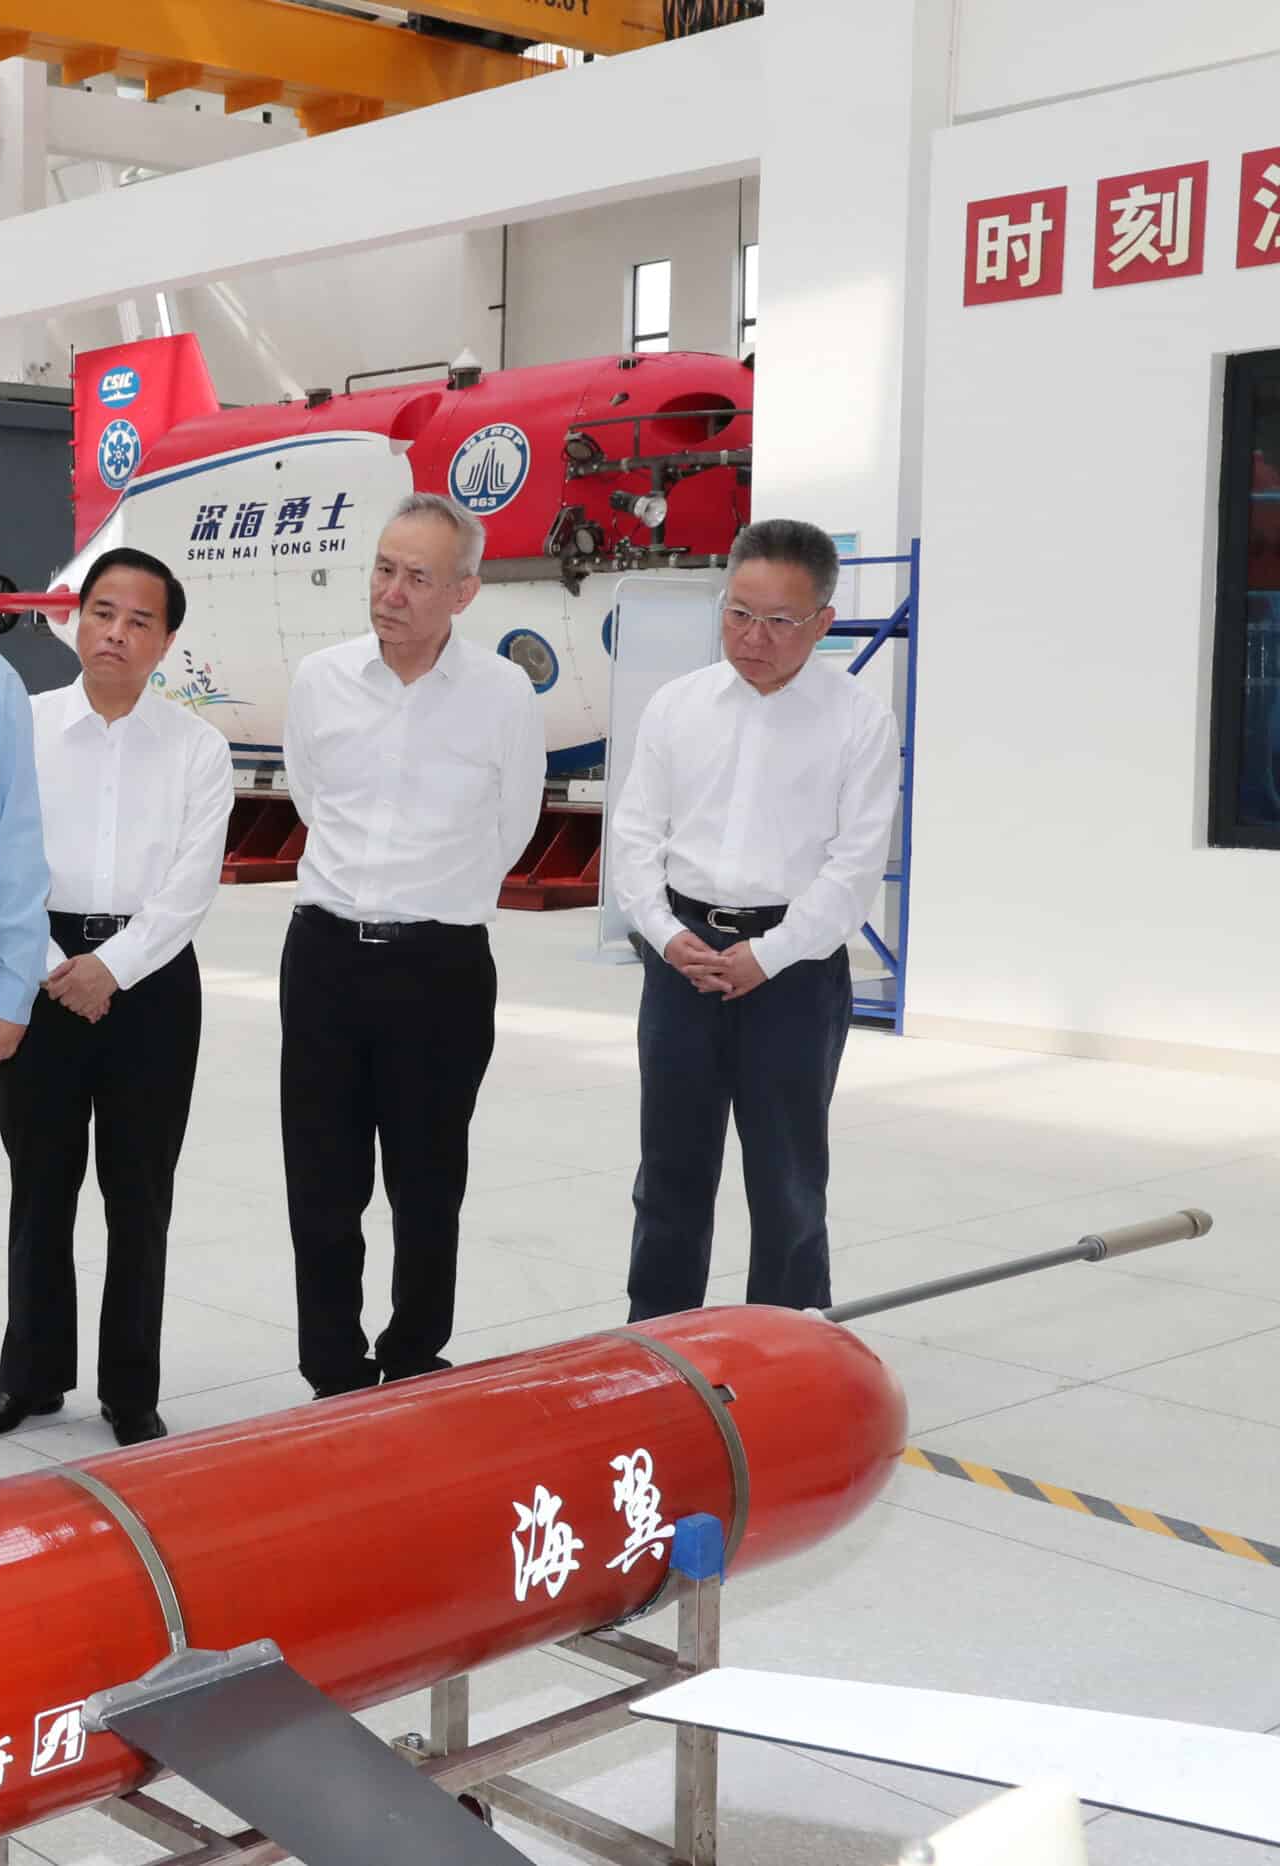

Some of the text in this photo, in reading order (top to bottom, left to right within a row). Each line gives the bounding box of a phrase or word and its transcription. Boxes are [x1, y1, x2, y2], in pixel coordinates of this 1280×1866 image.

[101, 371, 135, 392] CSIC
[469, 497, 497, 507] 863
[190, 492, 355, 541] 深海勇士
[187, 539, 346, 560] SHEN HAI YONG SHI
[511, 1447, 676, 1602] 海翼
